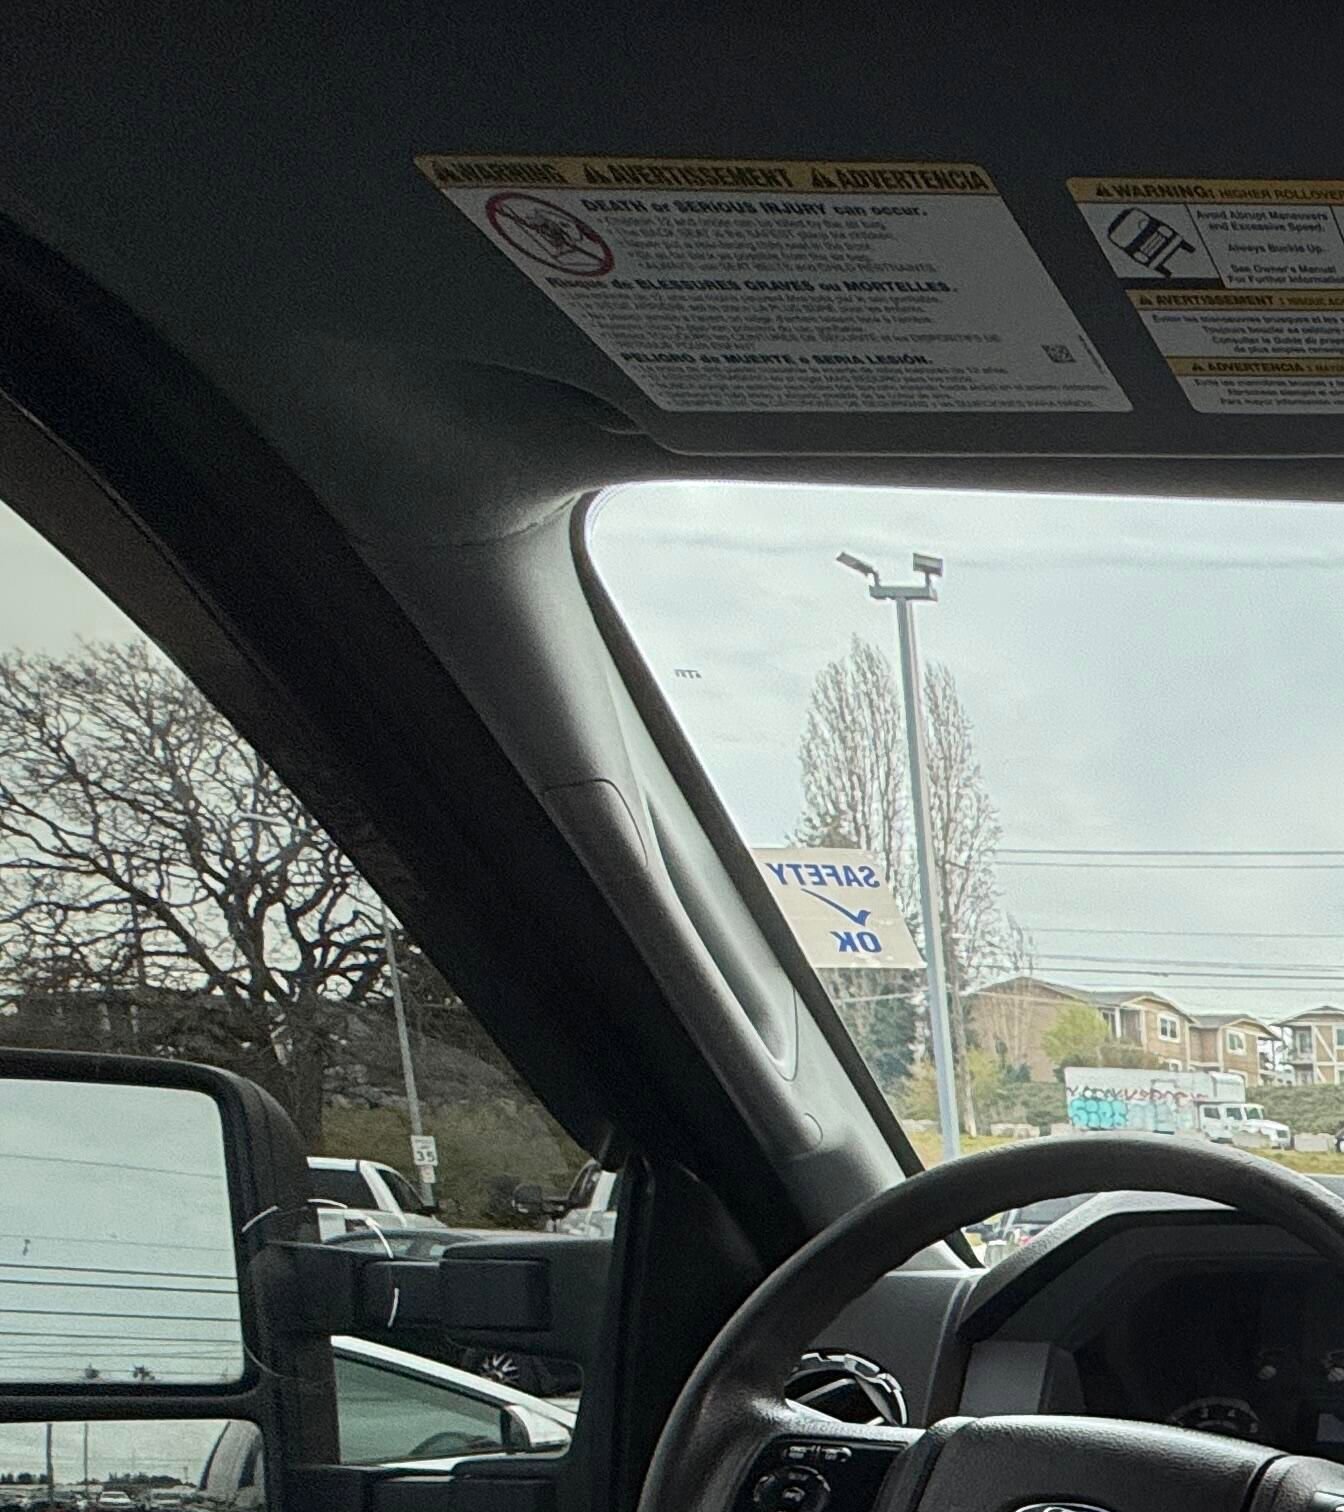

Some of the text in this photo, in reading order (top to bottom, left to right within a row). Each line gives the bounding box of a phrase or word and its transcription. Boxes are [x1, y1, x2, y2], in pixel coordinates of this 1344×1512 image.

[457, 163, 990, 191] WARNING AVERTISSEMENT ADVERTENCIA
[580, 200, 648, 214] DEATH
[679, 201, 757, 215] SERIOUS
[761, 203, 826, 217] INJURY
[639, 279, 742, 291] BLESSURES
[744, 281, 815, 292] GRAVES
[843, 281, 958, 293] MORTELLES.
[1156, 295, 1273, 306] AVERTISSEMENT
[620, 353, 695, 363] PELIGRO
[719, 354, 791, 364] MUERTE
[1208, 362, 1304, 372] ADVERTENCIA
[416, 1150, 435, 1163] 35
